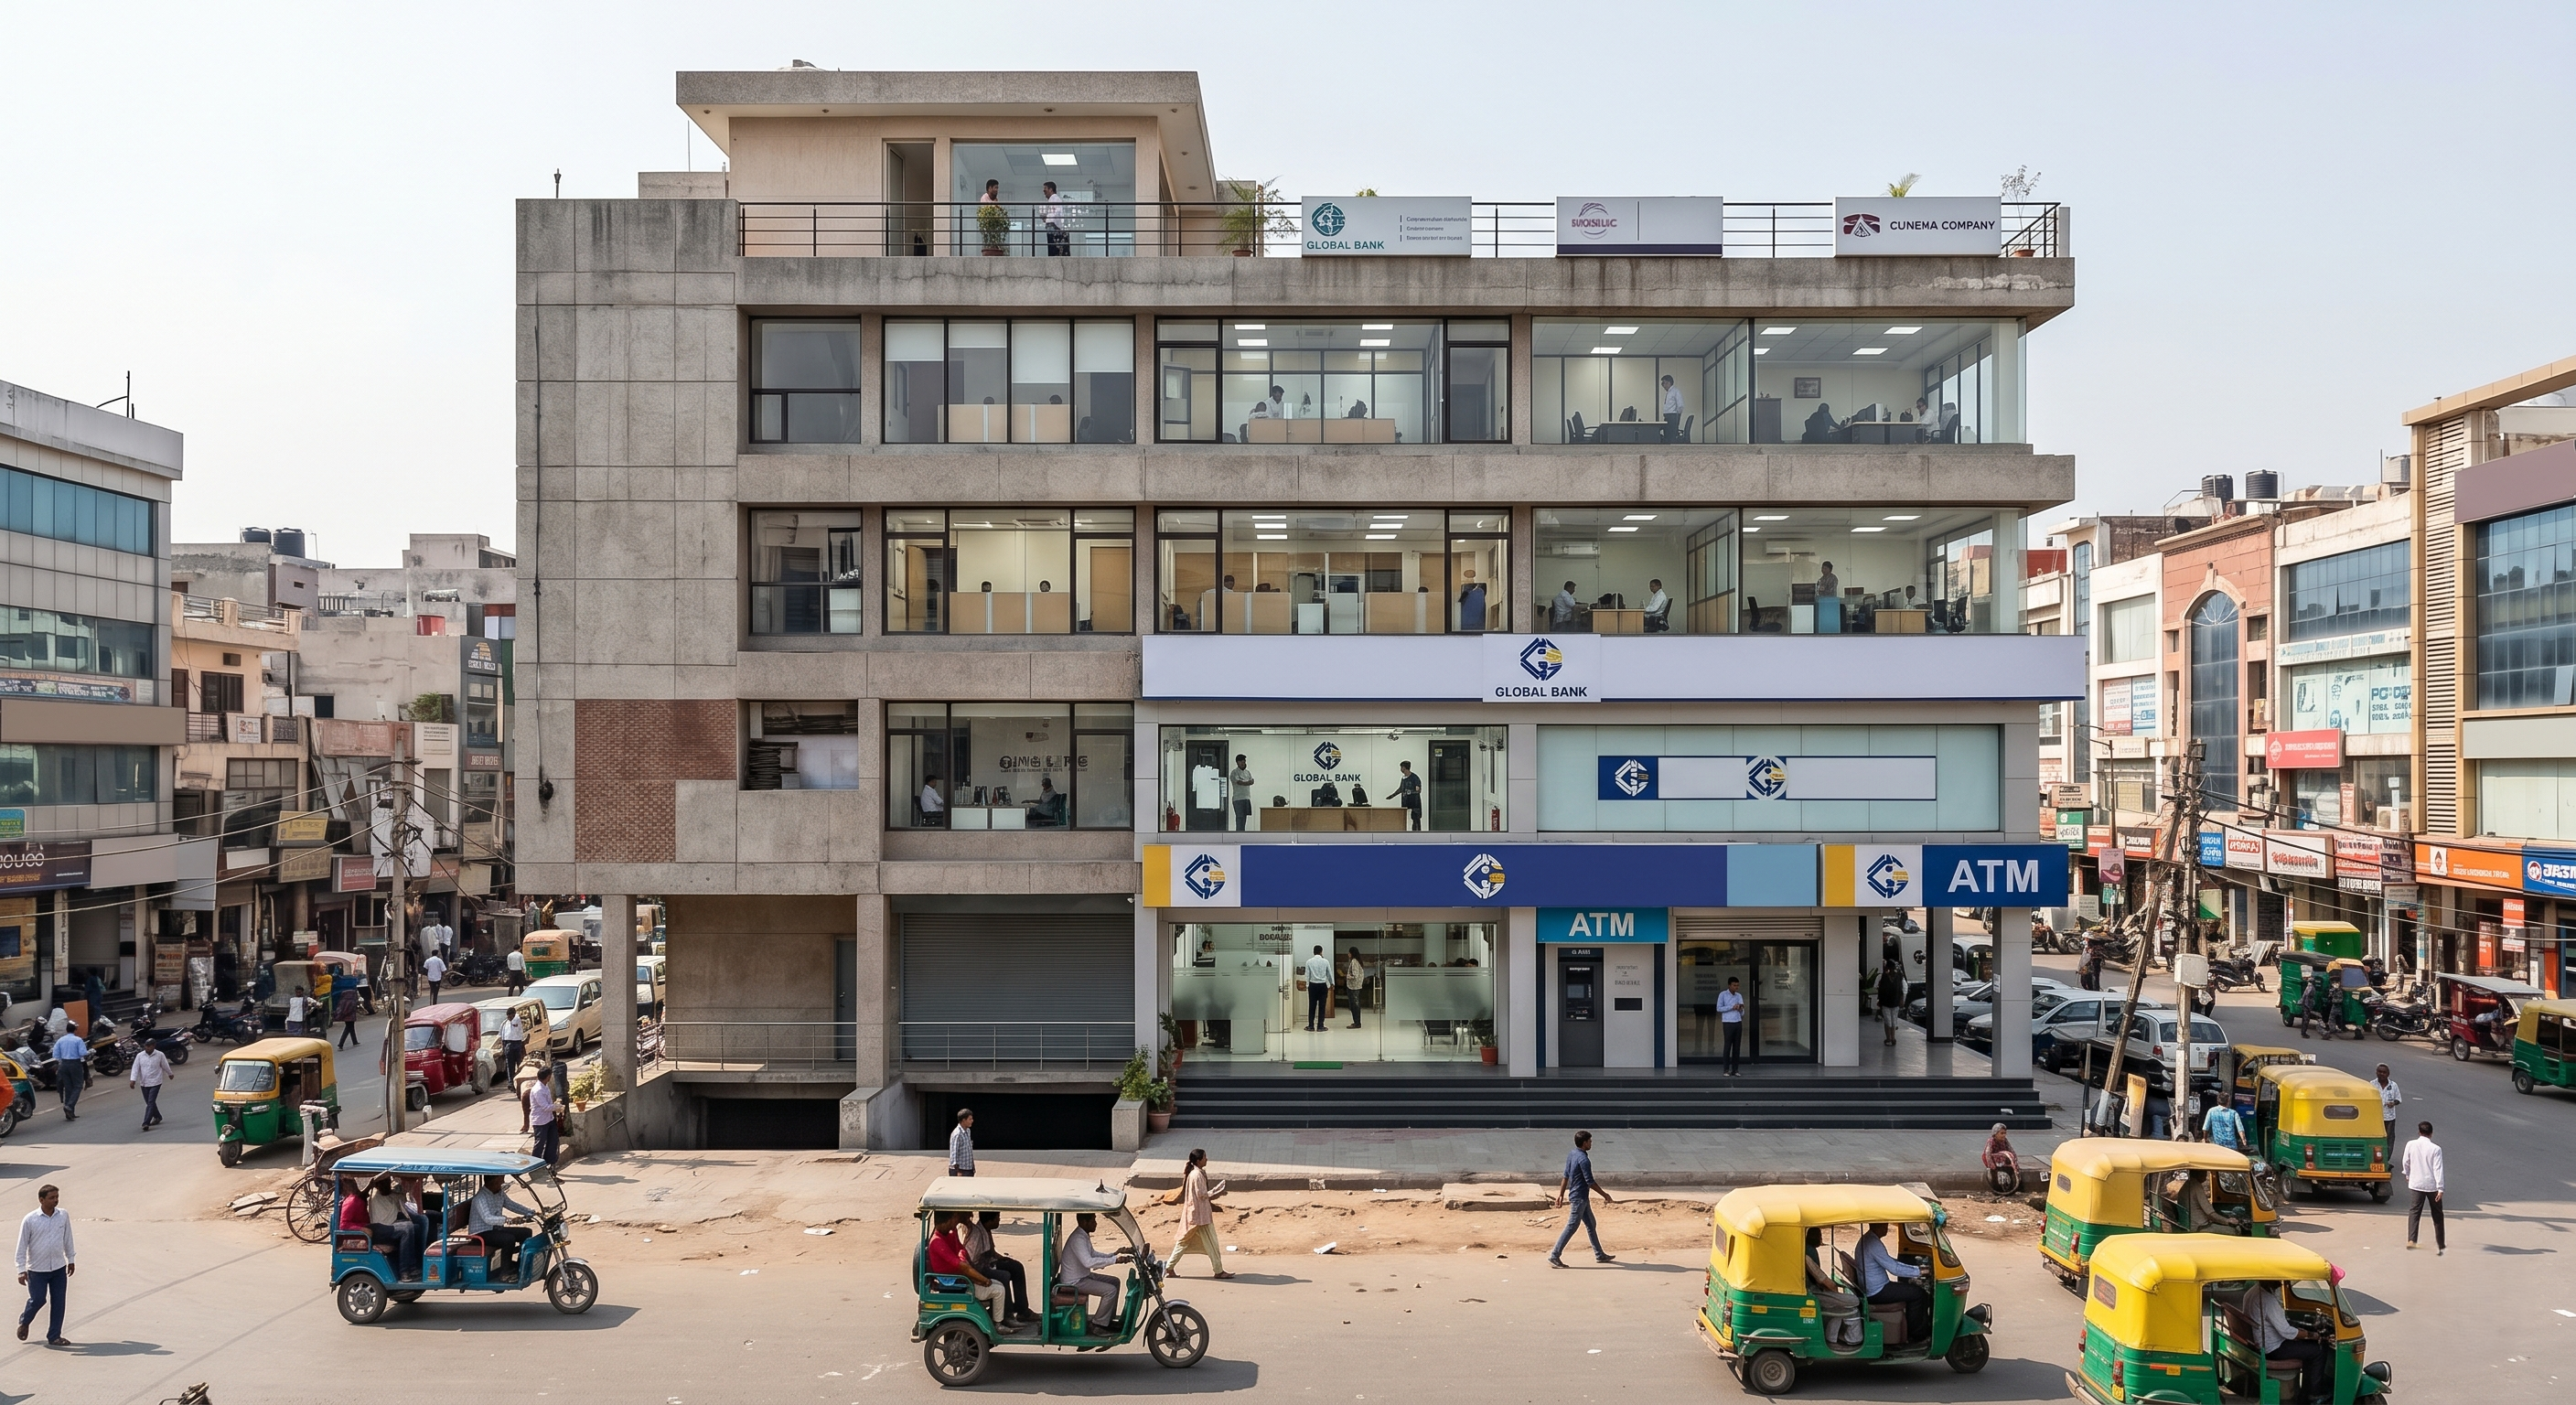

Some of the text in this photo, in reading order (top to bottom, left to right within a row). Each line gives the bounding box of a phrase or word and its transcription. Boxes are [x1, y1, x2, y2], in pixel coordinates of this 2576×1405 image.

[1889, 220, 1995, 231] CUNEMA COMPANY
[1306, 241, 1385, 250] GLOBAL BANK
[1495, 686, 1588, 697] GLOBAL BANK
[1293, 773, 1361, 782] GLOBAL BANK
[1947, 859, 2039, 893] ATM
[1568, 912, 1635, 937] ATM
